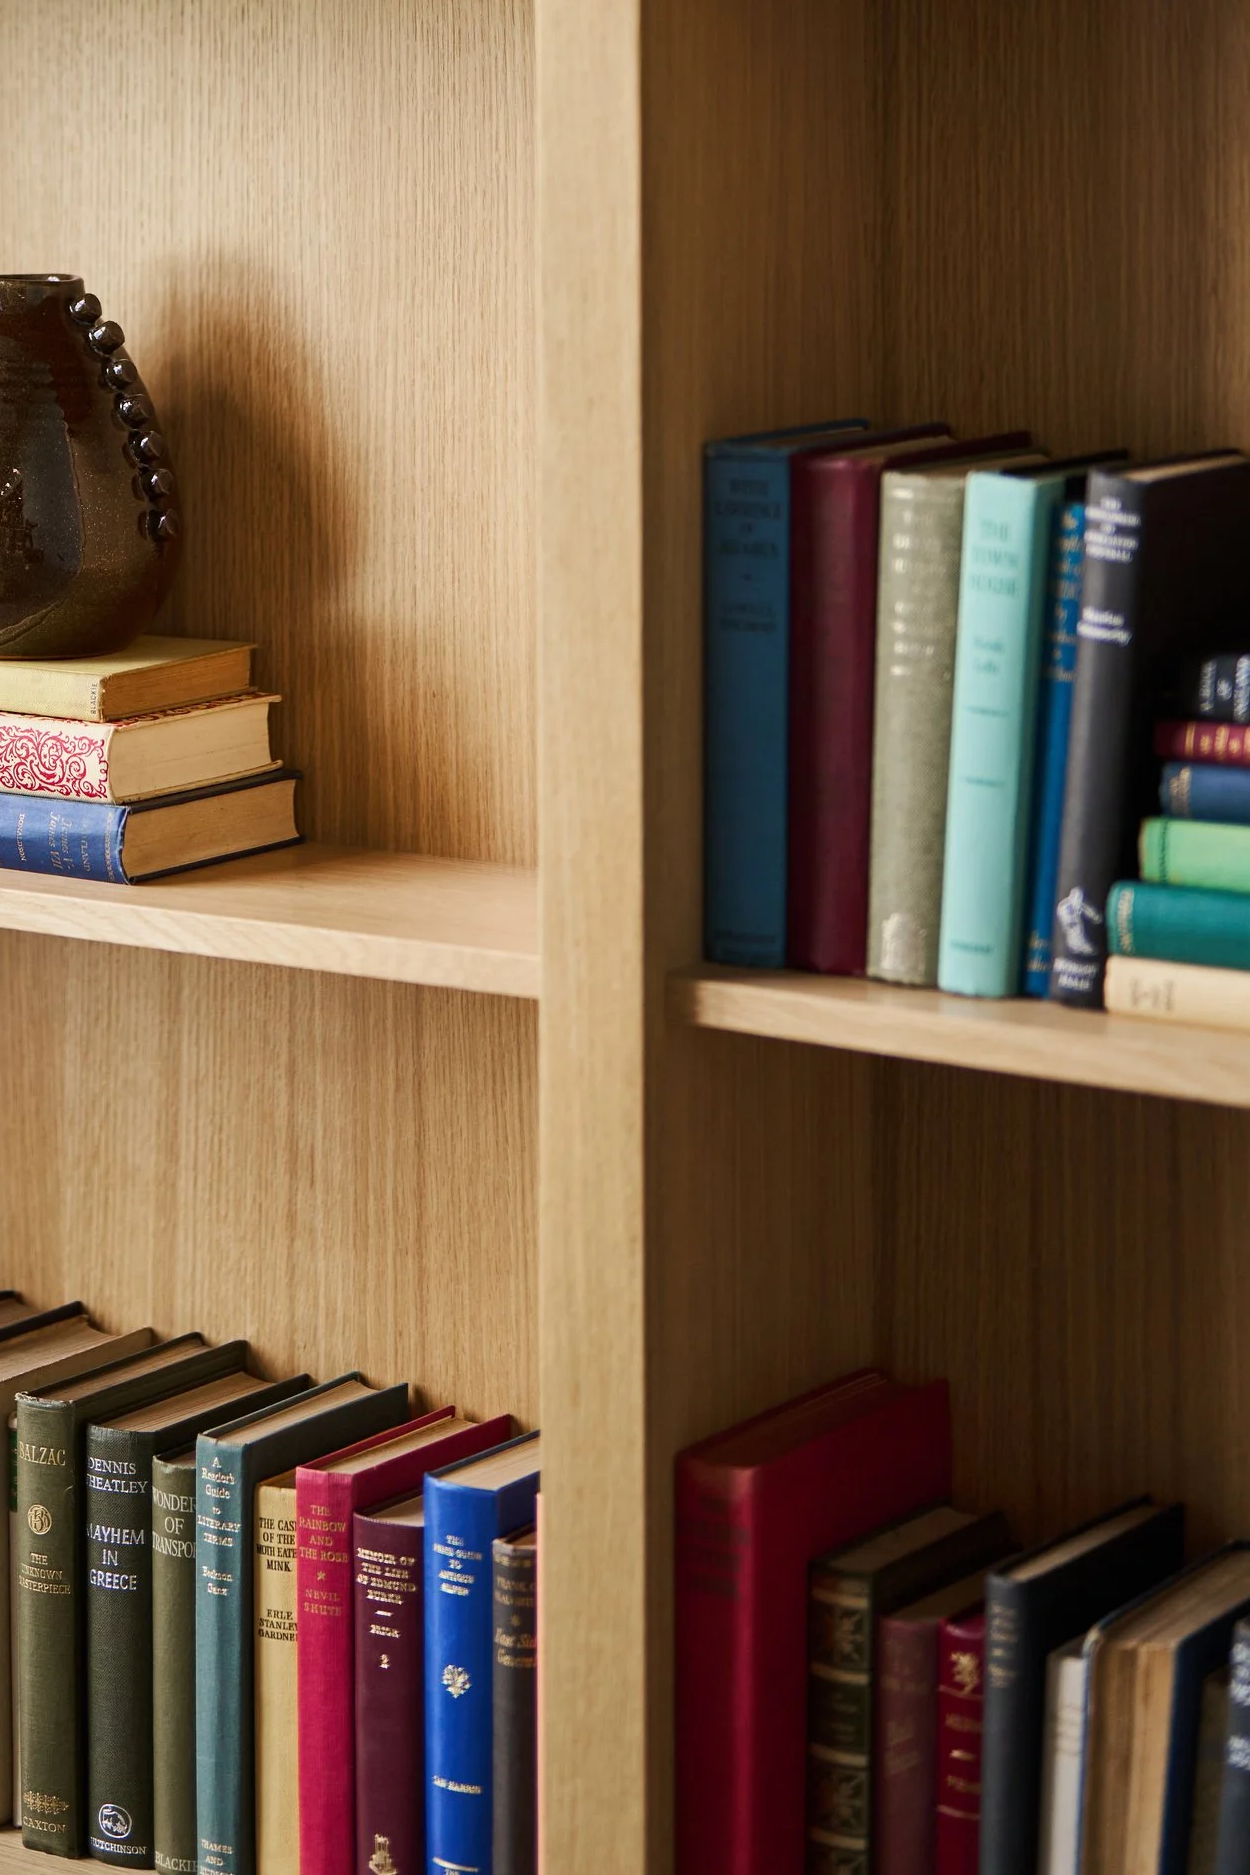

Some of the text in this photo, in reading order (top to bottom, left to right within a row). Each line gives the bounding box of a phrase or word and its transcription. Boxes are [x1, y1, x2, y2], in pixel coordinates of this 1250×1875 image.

[16, 812, 27, 862] DONALDSON
[18, 1441, 66, 1467] BALZAC
[212, 1456, 222, 1469] A
[205, 1483, 231, 1500] Guide
[212, 1506, 222, 1516] to
[310, 1504, 332, 1518] THE
[163, 1516, 185, 1535] OF
[197, 1514, 242, 1533] LITERARY
[259, 1516, 275, 1531] THE
[299, 1516, 347, 1533] RAINBOW
[203, 1532, 234, 1548] TERMS
[262, 1531, 296, 1546] OF THE
[309, 1534, 334, 1547] AND
[101, 1547, 119, 1567] IN
[256, 1543, 276, 1557] MOTH
[299, 1546, 349, 1564] THE ROSE
[356, 1546, 416, 1567] MEMOIR OF
[30, 1552, 49, 1566] THE
[266, 1558, 293, 1573] MINK
[361, 1561, 409, 1580] THE LIFE
[89, 1568, 138, 1592] GREECE
[356, 1573, 418, 1593] OF EDMUND
[305, 1588, 341, 1602] NEVIL
[365, 1588, 405, 1606] BURKE
[266, 1608, 293, 1621] ERLE
[304, 1602, 343, 1617] SHUTE
[259, 1618, 298, 1633] STANLEY
[379, 1653, 391, 1670] 2
[22, 1815, 67, 1834] CAXTON
[90, 1835, 147, 1856] HUTCHINSON
[200, 1838, 234, 1855] THAMES
[205, 1855, 225, 1867] AND
